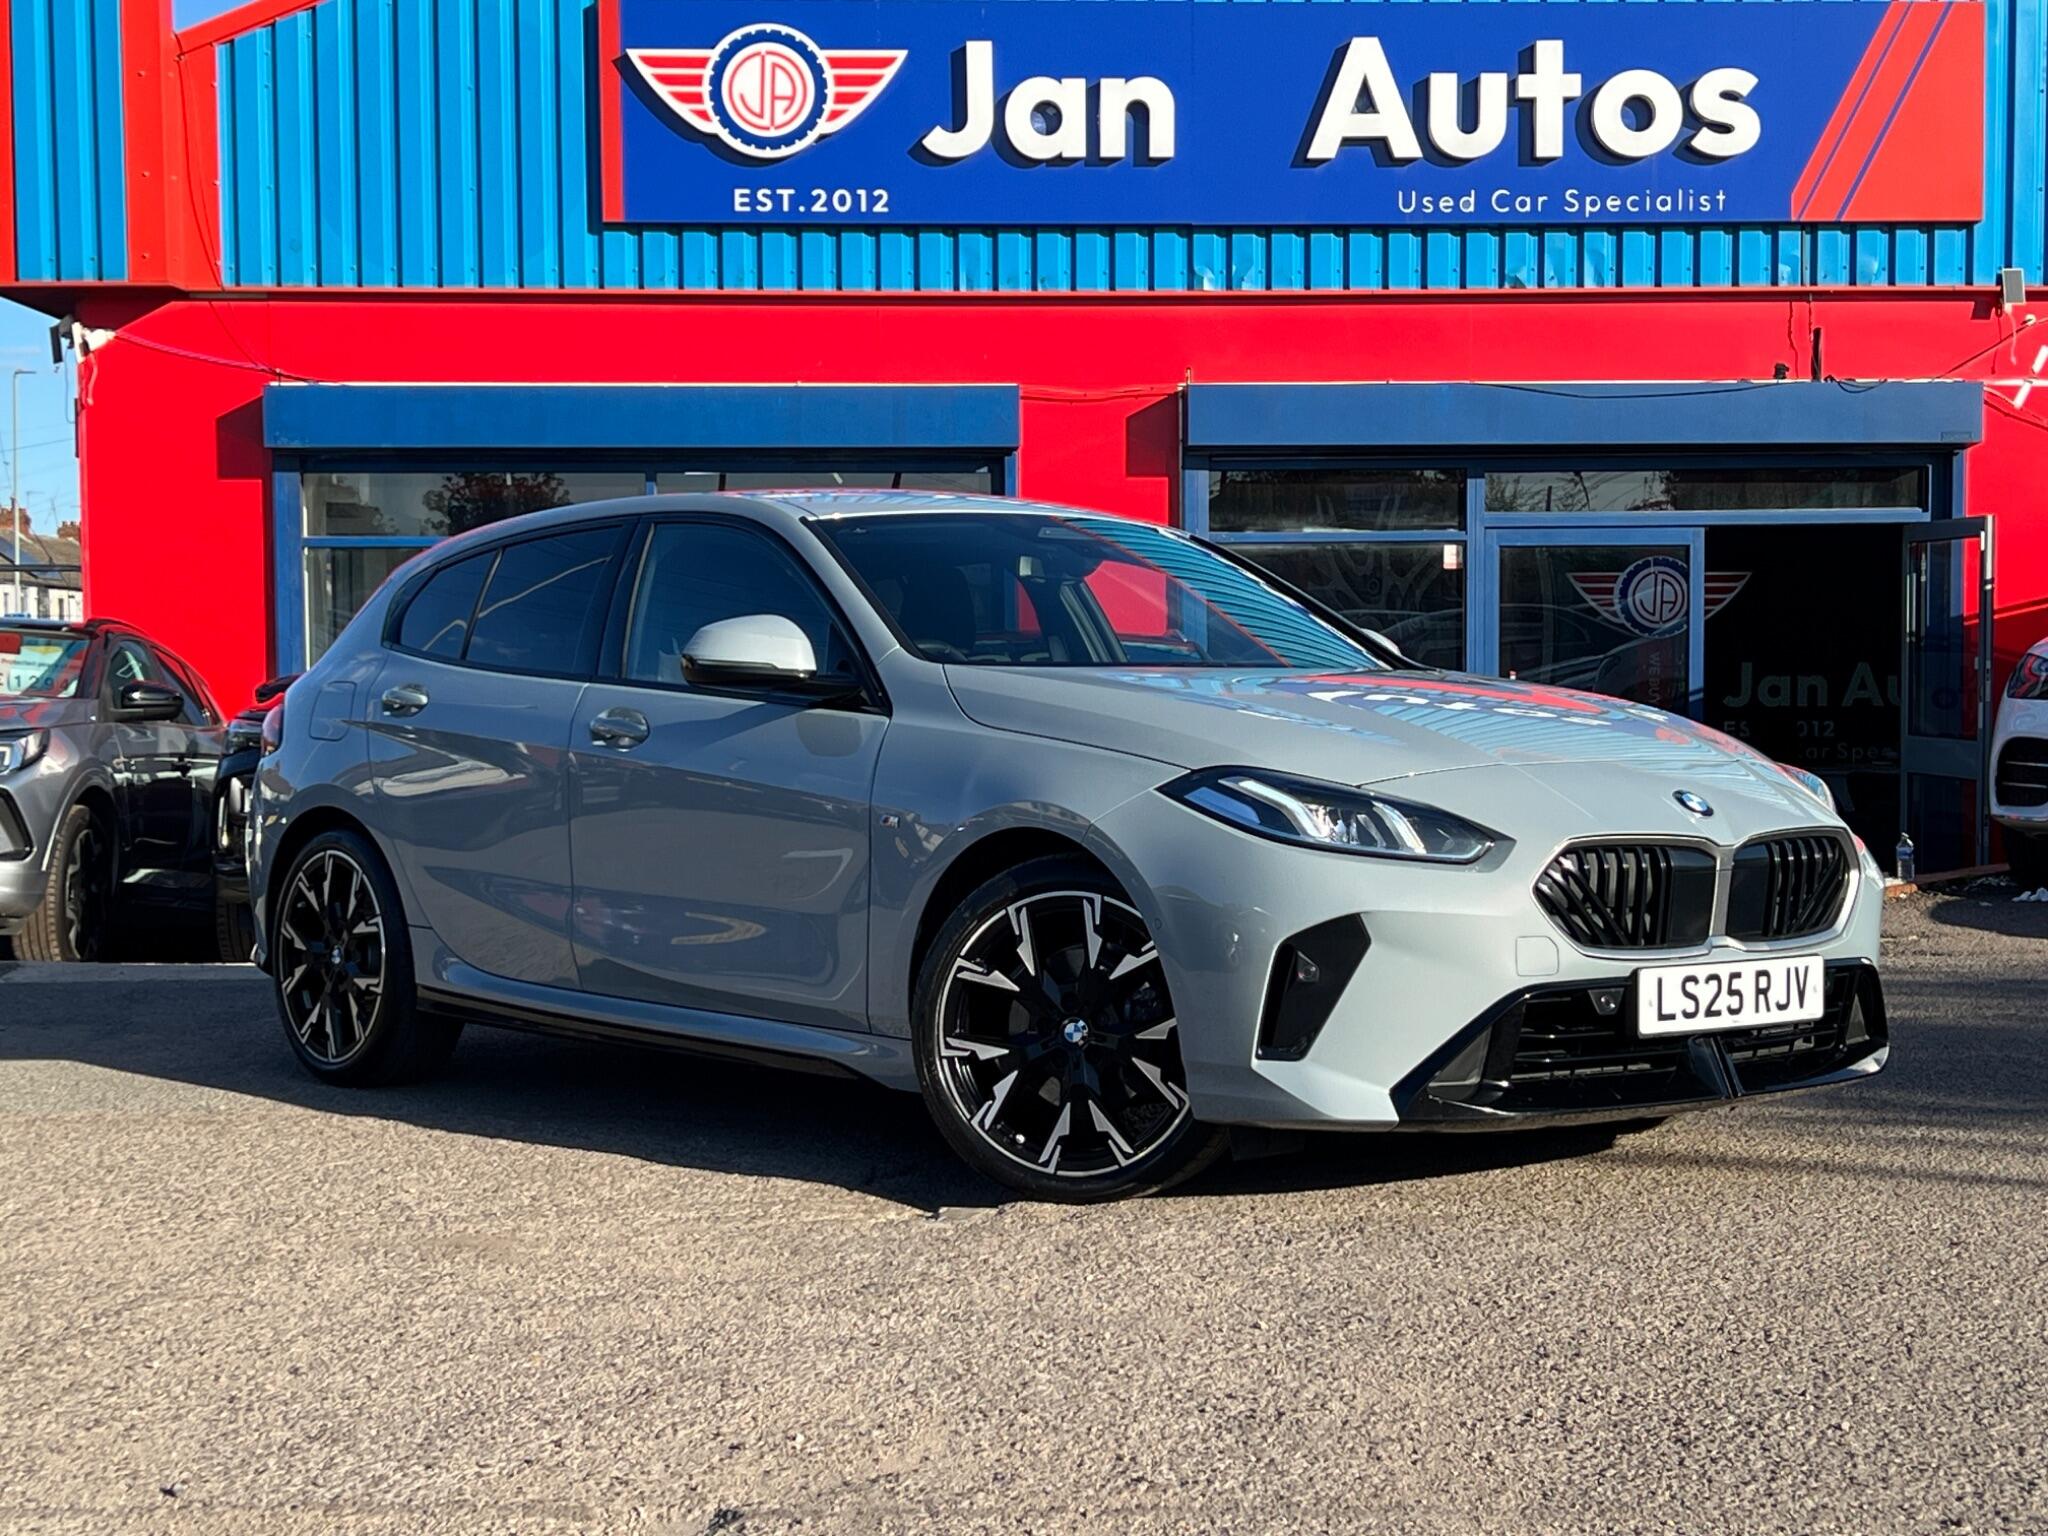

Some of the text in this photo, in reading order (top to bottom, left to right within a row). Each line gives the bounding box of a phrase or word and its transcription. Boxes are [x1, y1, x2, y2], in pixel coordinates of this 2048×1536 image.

[921, 36, 1762, 161] Jan Autos
[733, 188, 891, 213] EST.2012
[1397, 188, 1727, 218] Used Car Specialist
[1723, 661, 1829, 707] Jan
[1657, 966, 1809, 1021] LS25 RJV
